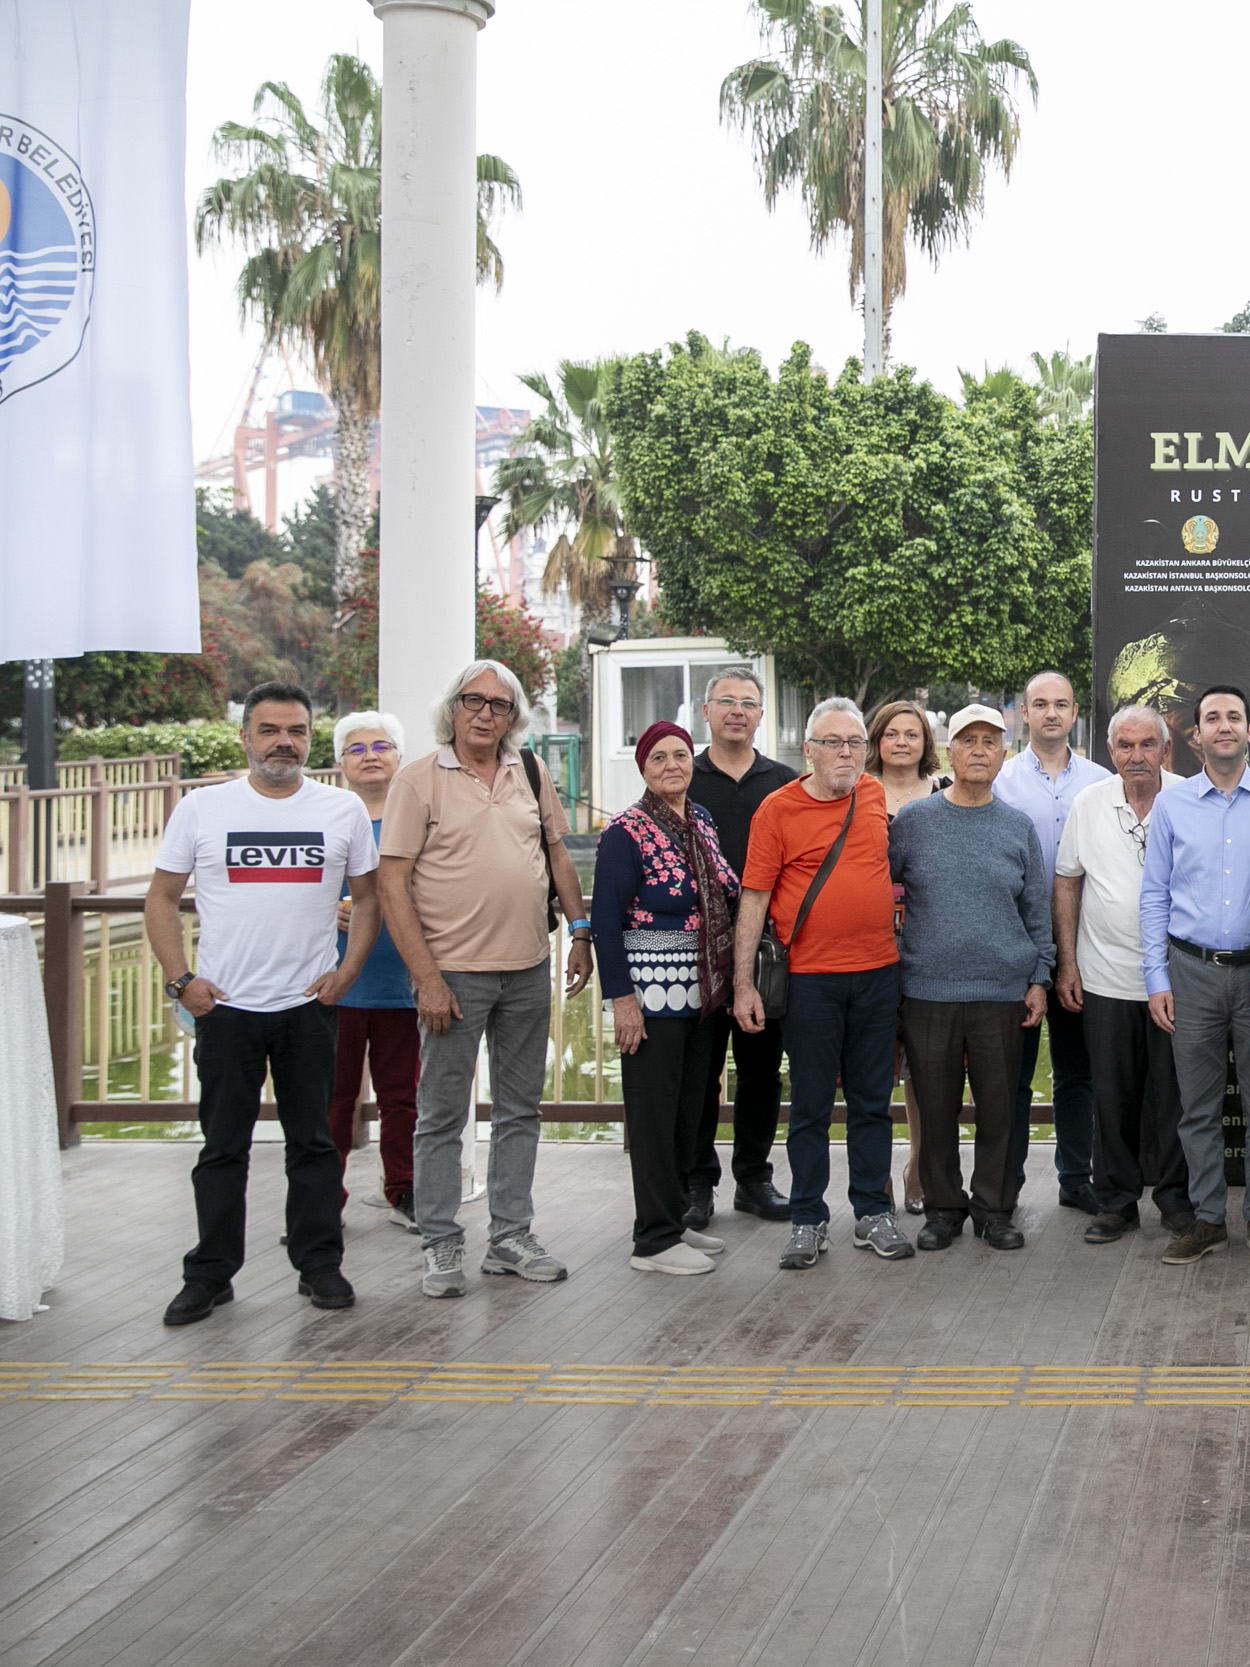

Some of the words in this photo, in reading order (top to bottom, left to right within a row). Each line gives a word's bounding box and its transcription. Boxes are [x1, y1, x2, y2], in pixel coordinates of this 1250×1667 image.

[1136, 558, 1180, 567] KAZAKİSTAN
[1181, 559, 1211, 567] ANKARA
[1124, 570, 1168, 579] KAZAKİSTAN
[1169, 571, 1204, 579] İSTANBUL
[1125, 583, 1169, 592] KAZAKİSTAN
[1170, 584, 1203, 592] ANTALYA
